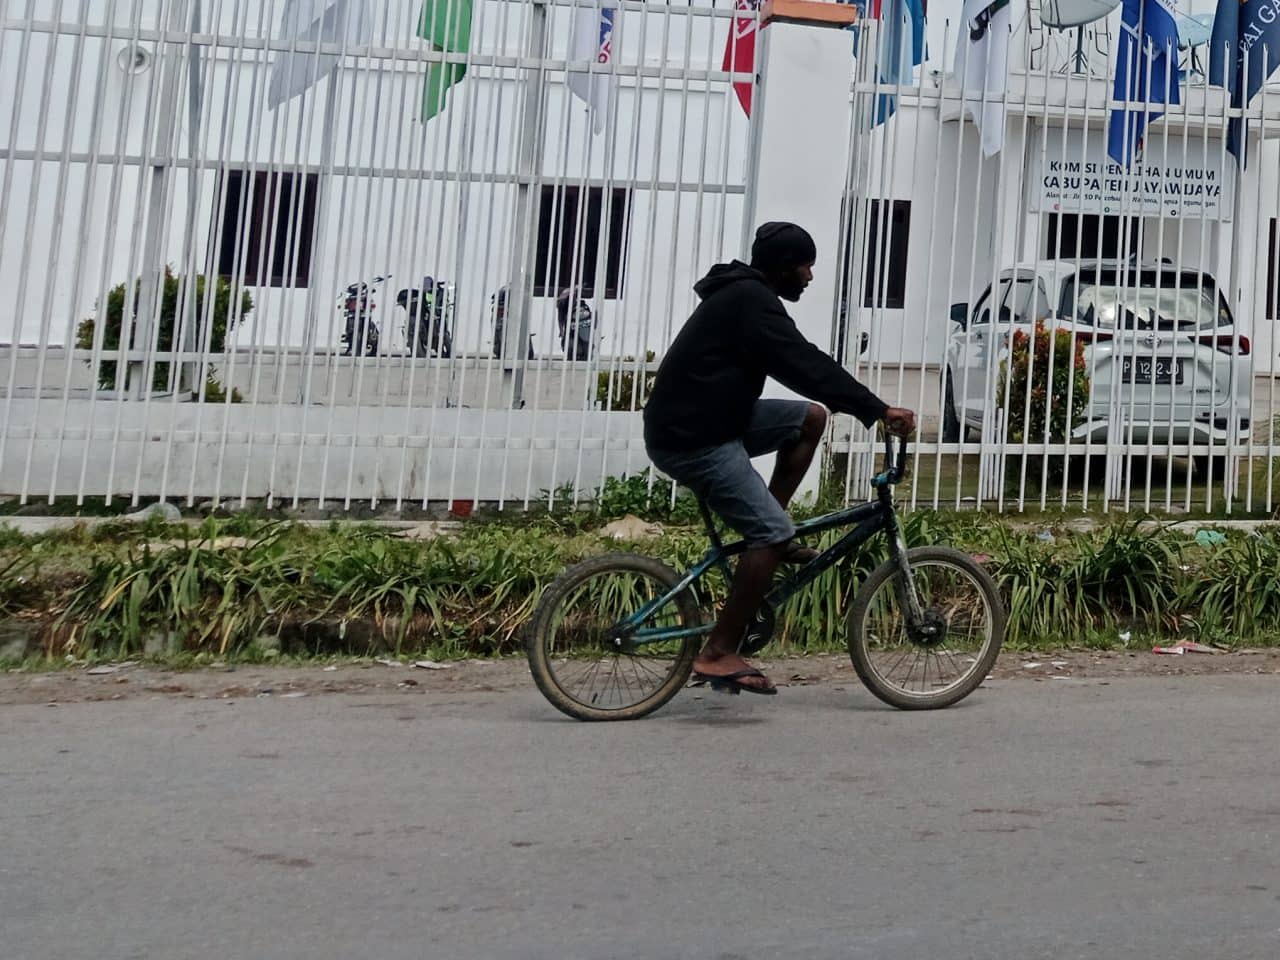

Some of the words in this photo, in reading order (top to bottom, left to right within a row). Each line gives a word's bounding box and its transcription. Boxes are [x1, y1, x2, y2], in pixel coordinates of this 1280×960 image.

[1050, 161, 1097, 173] KOMSI
[1174, 168, 1215, 180] UMUM
[1141, 362, 1164, 375] 122
